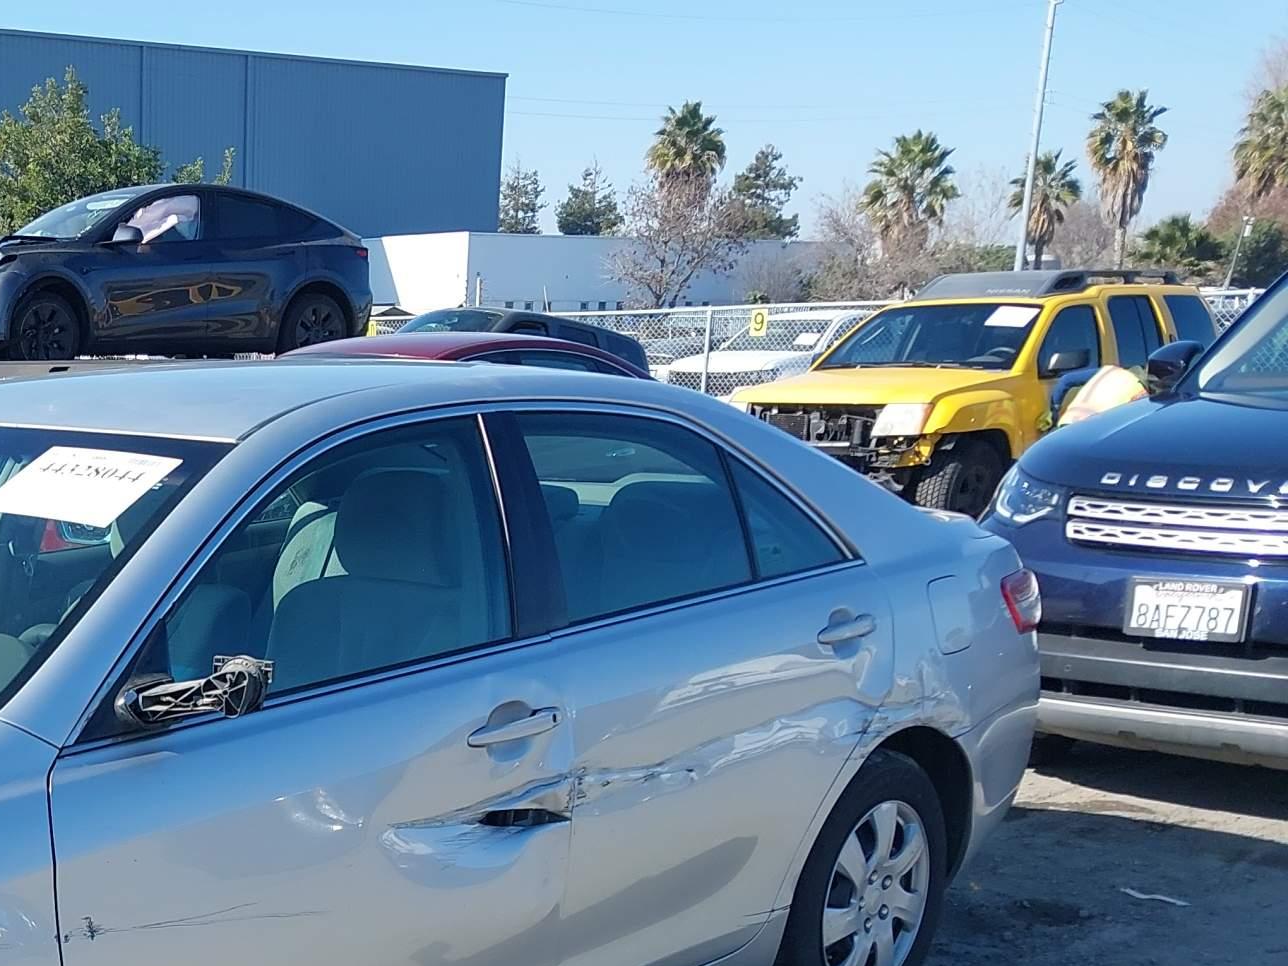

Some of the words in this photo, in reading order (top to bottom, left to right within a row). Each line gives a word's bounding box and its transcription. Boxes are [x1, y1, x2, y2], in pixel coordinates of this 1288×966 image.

[754, 312, 765, 331] 9
[1159, 582, 1184, 591] LAND
[1185, 583, 1218, 593] ROVER
[1154, 628, 1177, 639] SAN
[1178, 629, 1209, 641] JOSE
